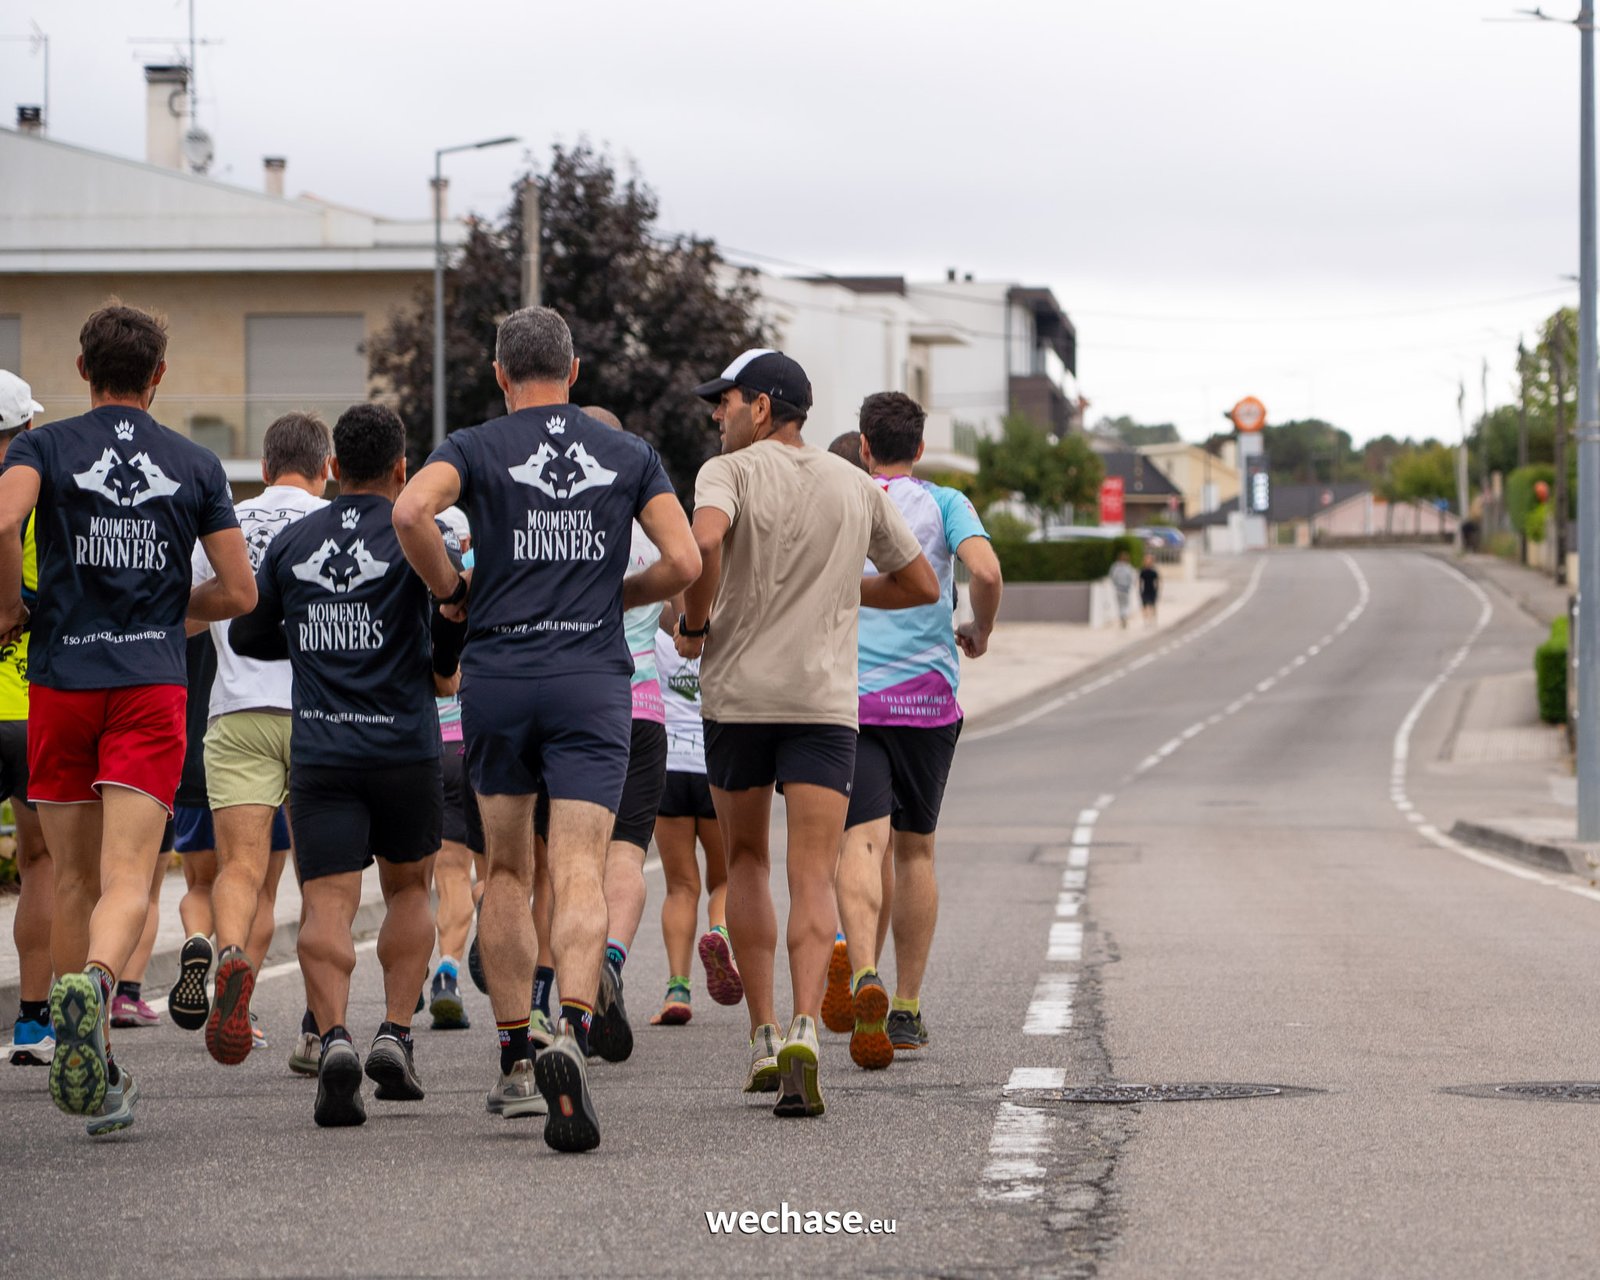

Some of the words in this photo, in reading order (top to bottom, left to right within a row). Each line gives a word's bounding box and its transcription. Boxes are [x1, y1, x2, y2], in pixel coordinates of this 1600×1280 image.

[90, 516, 156, 540] MOIMENTA
[528, 510, 593, 531] MOIMENTA
[75, 535, 169, 571] RUNNERS
[513, 529, 606, 561] RUNNERS
[308, 602, 370, 622] MOIMENTA
[299, 620, 383, 652] RUNNERS
